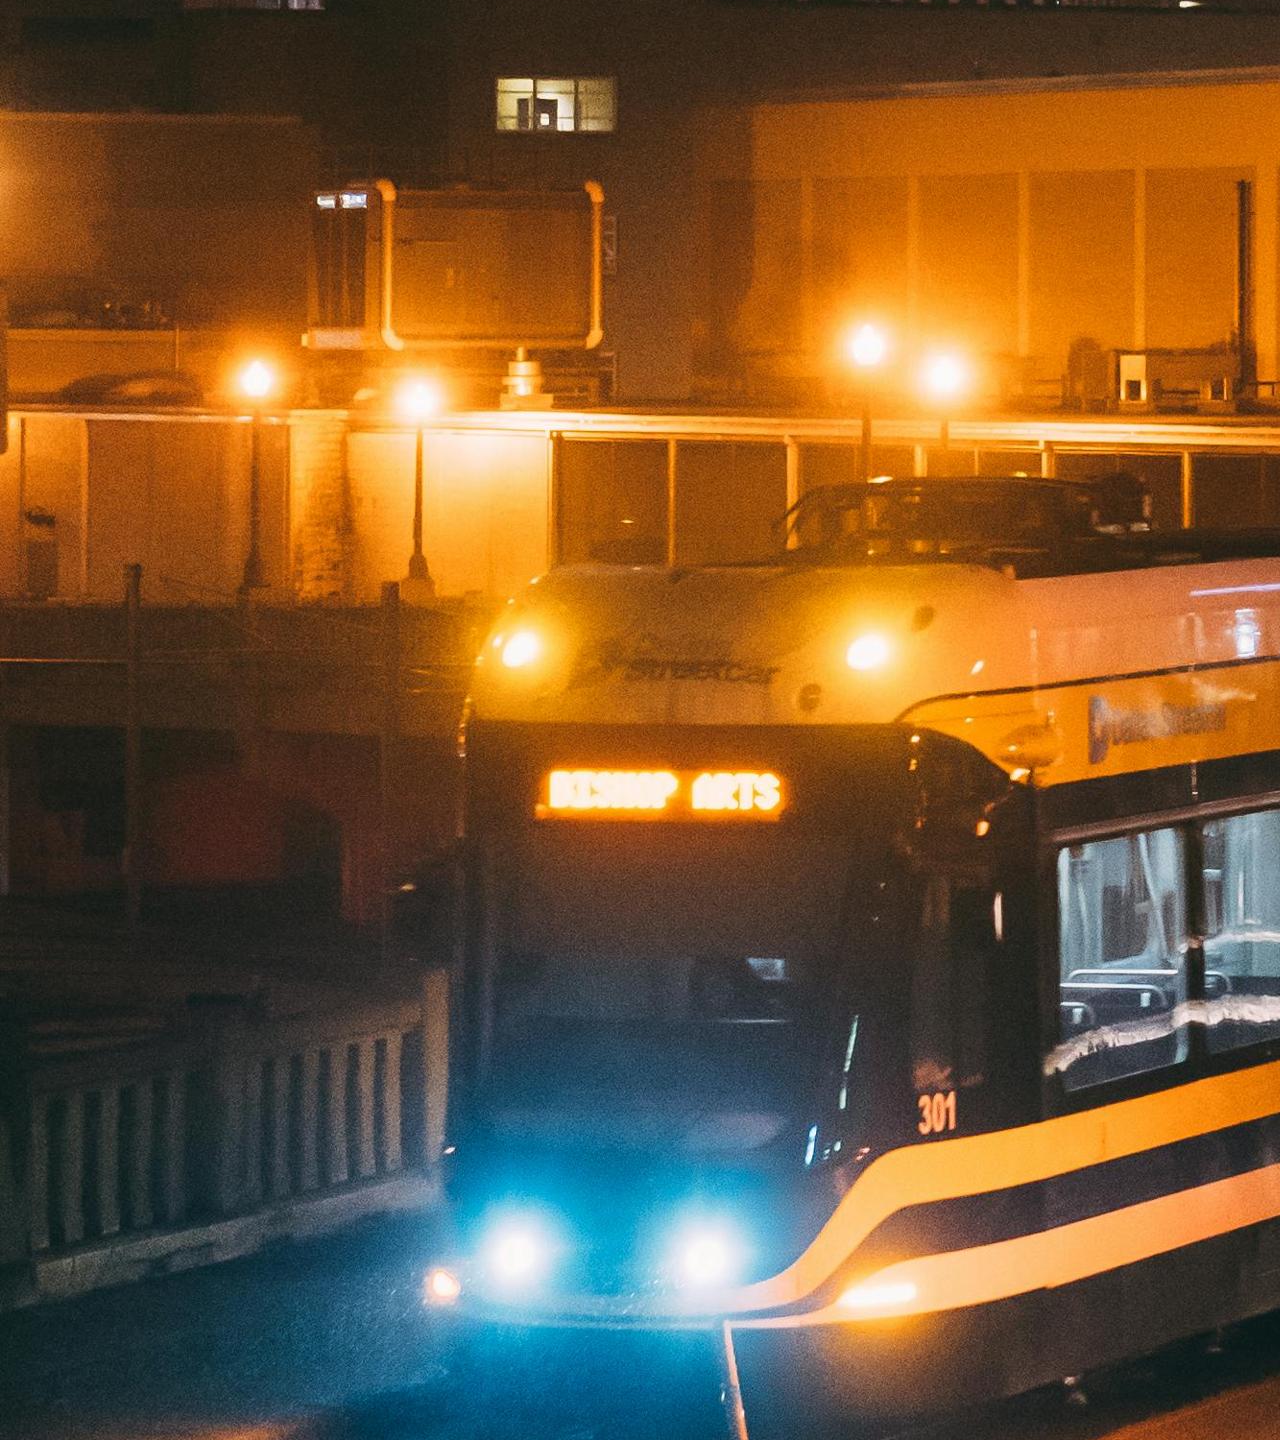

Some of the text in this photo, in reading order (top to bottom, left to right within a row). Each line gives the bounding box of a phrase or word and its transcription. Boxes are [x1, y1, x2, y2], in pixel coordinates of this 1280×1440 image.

[549, 771, 781, 810] BISHOP ARTS
[917, 1090, 957, 1135] 301
